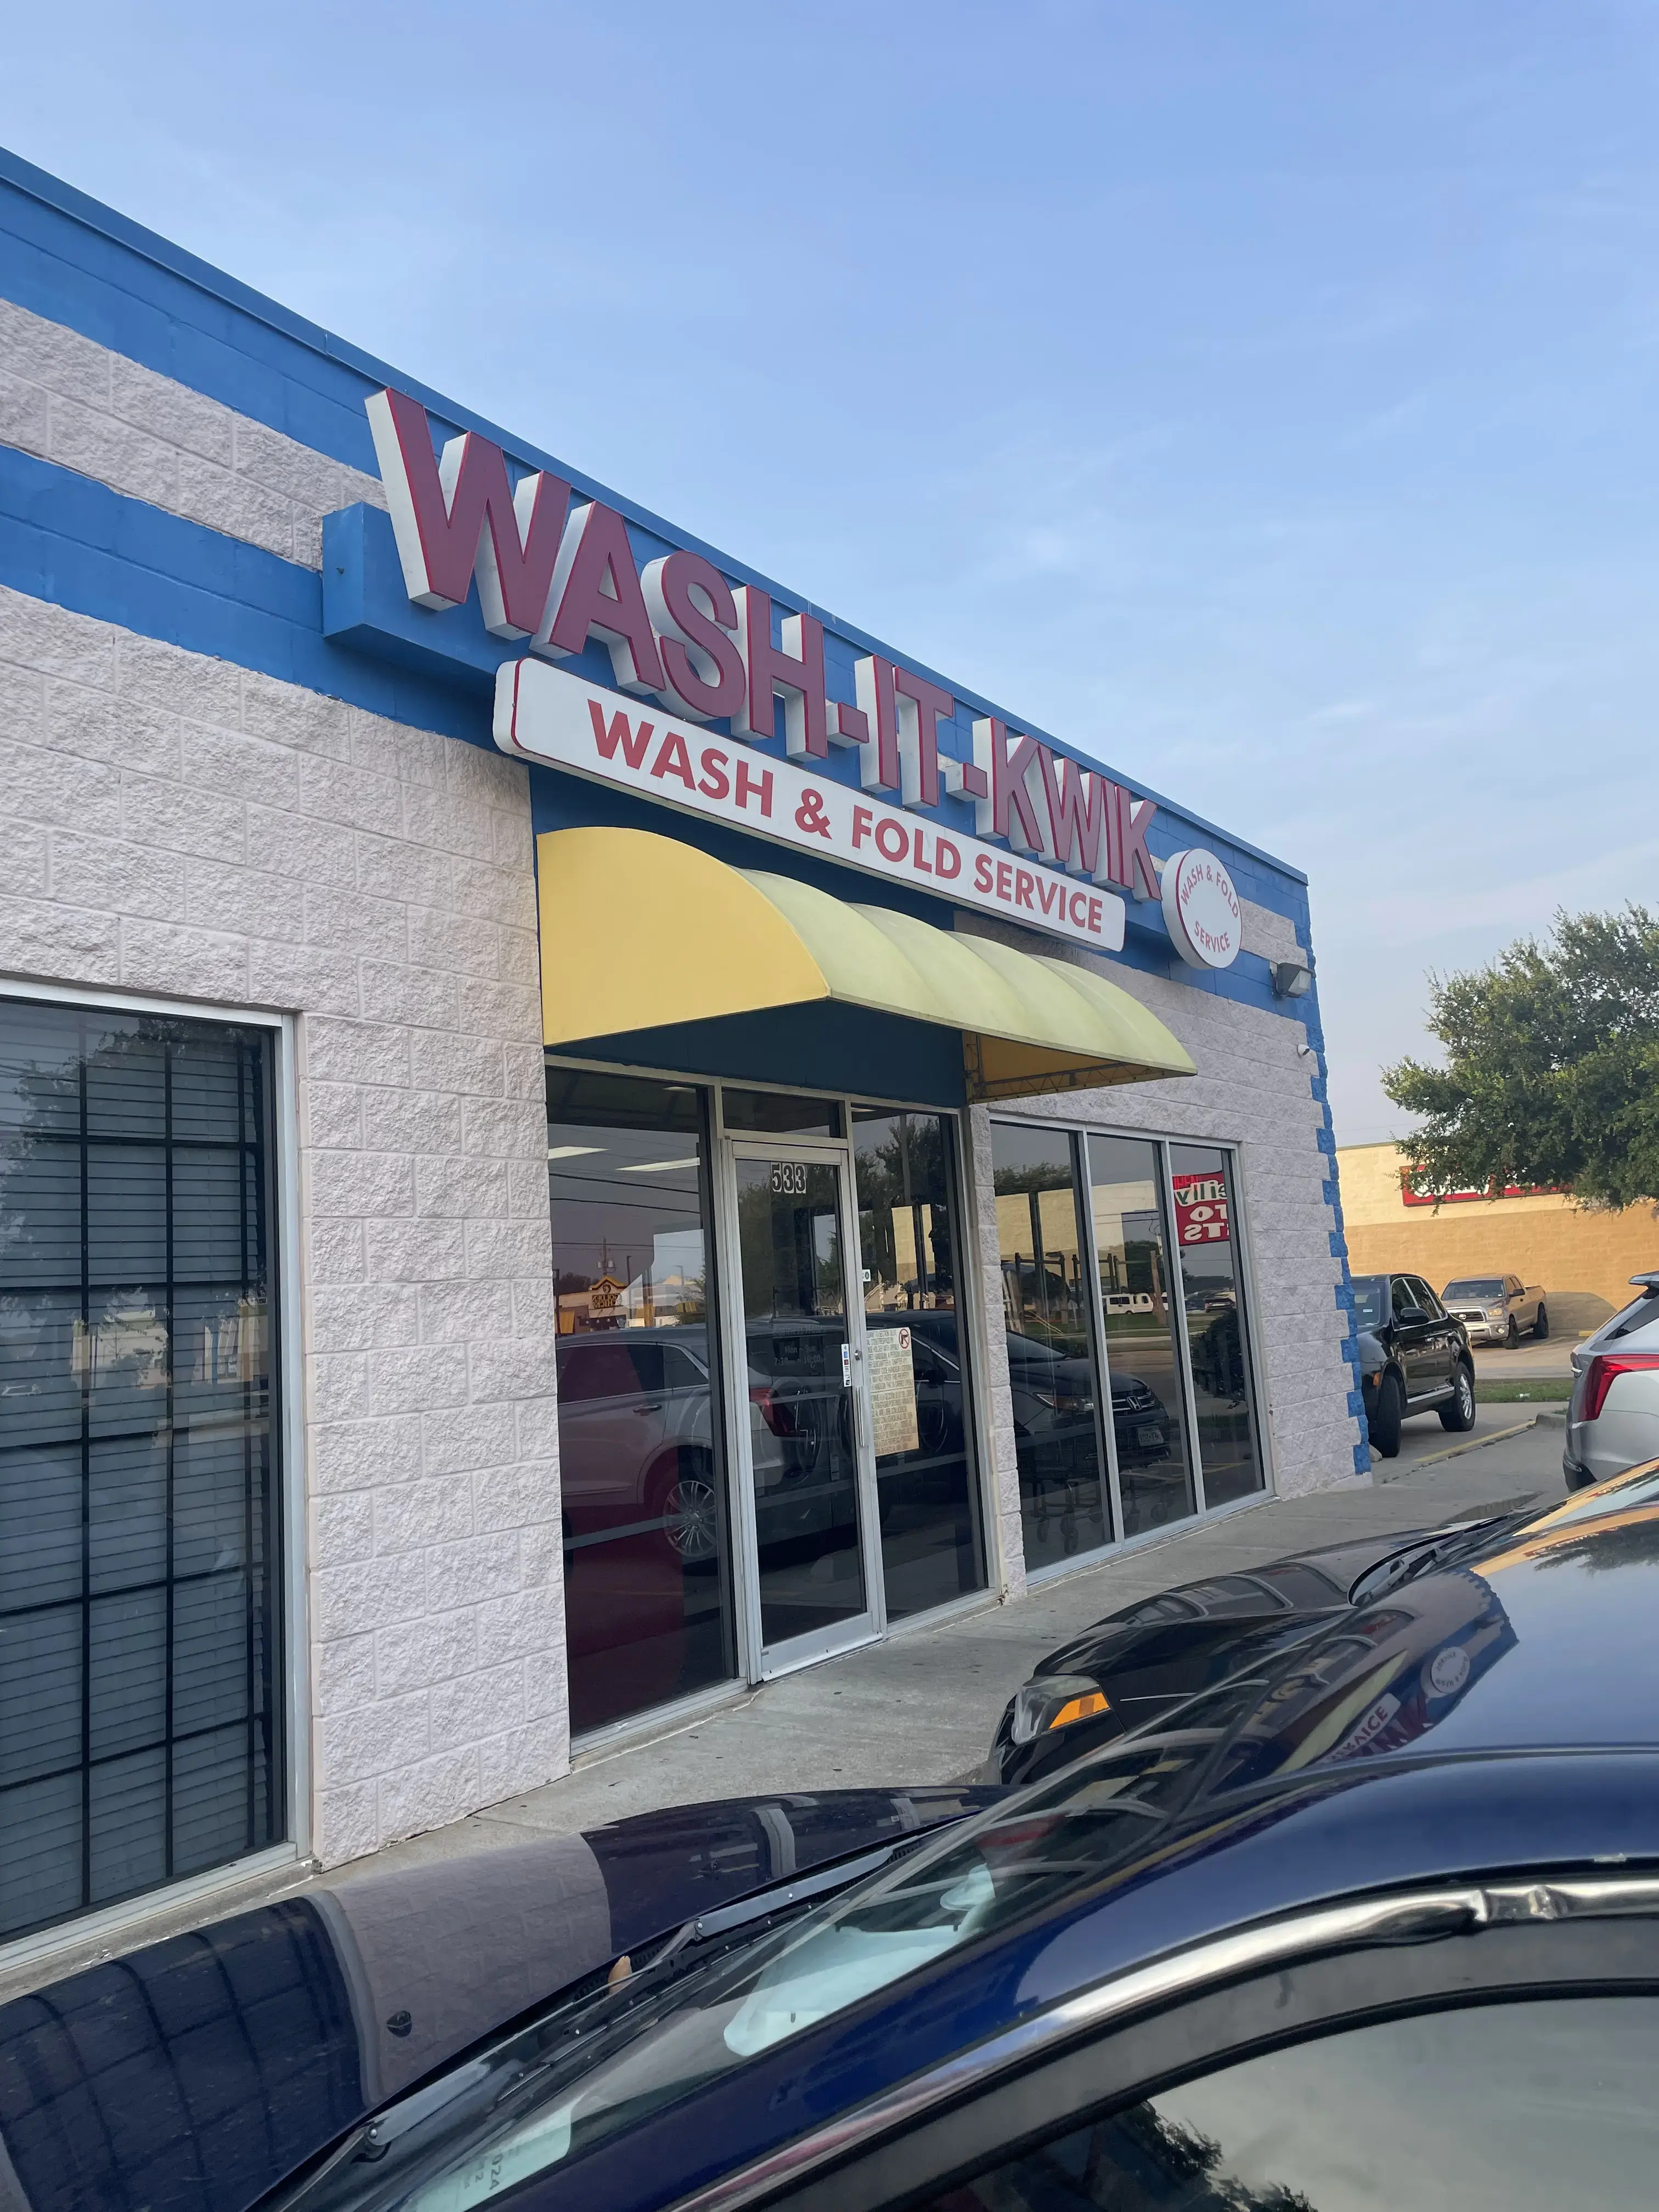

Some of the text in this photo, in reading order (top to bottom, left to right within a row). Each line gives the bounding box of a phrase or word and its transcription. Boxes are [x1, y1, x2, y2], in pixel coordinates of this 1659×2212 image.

[587, 698, 1103, 934] WASH & FOLD SERVICE
[1181, 864, 1239, 918] WASH & FOLD
[1194, 921, 1231, 953] SERVICE
[771, 1163, 806, 1192] 533
[785, 1345, 798, 1353] Mon
